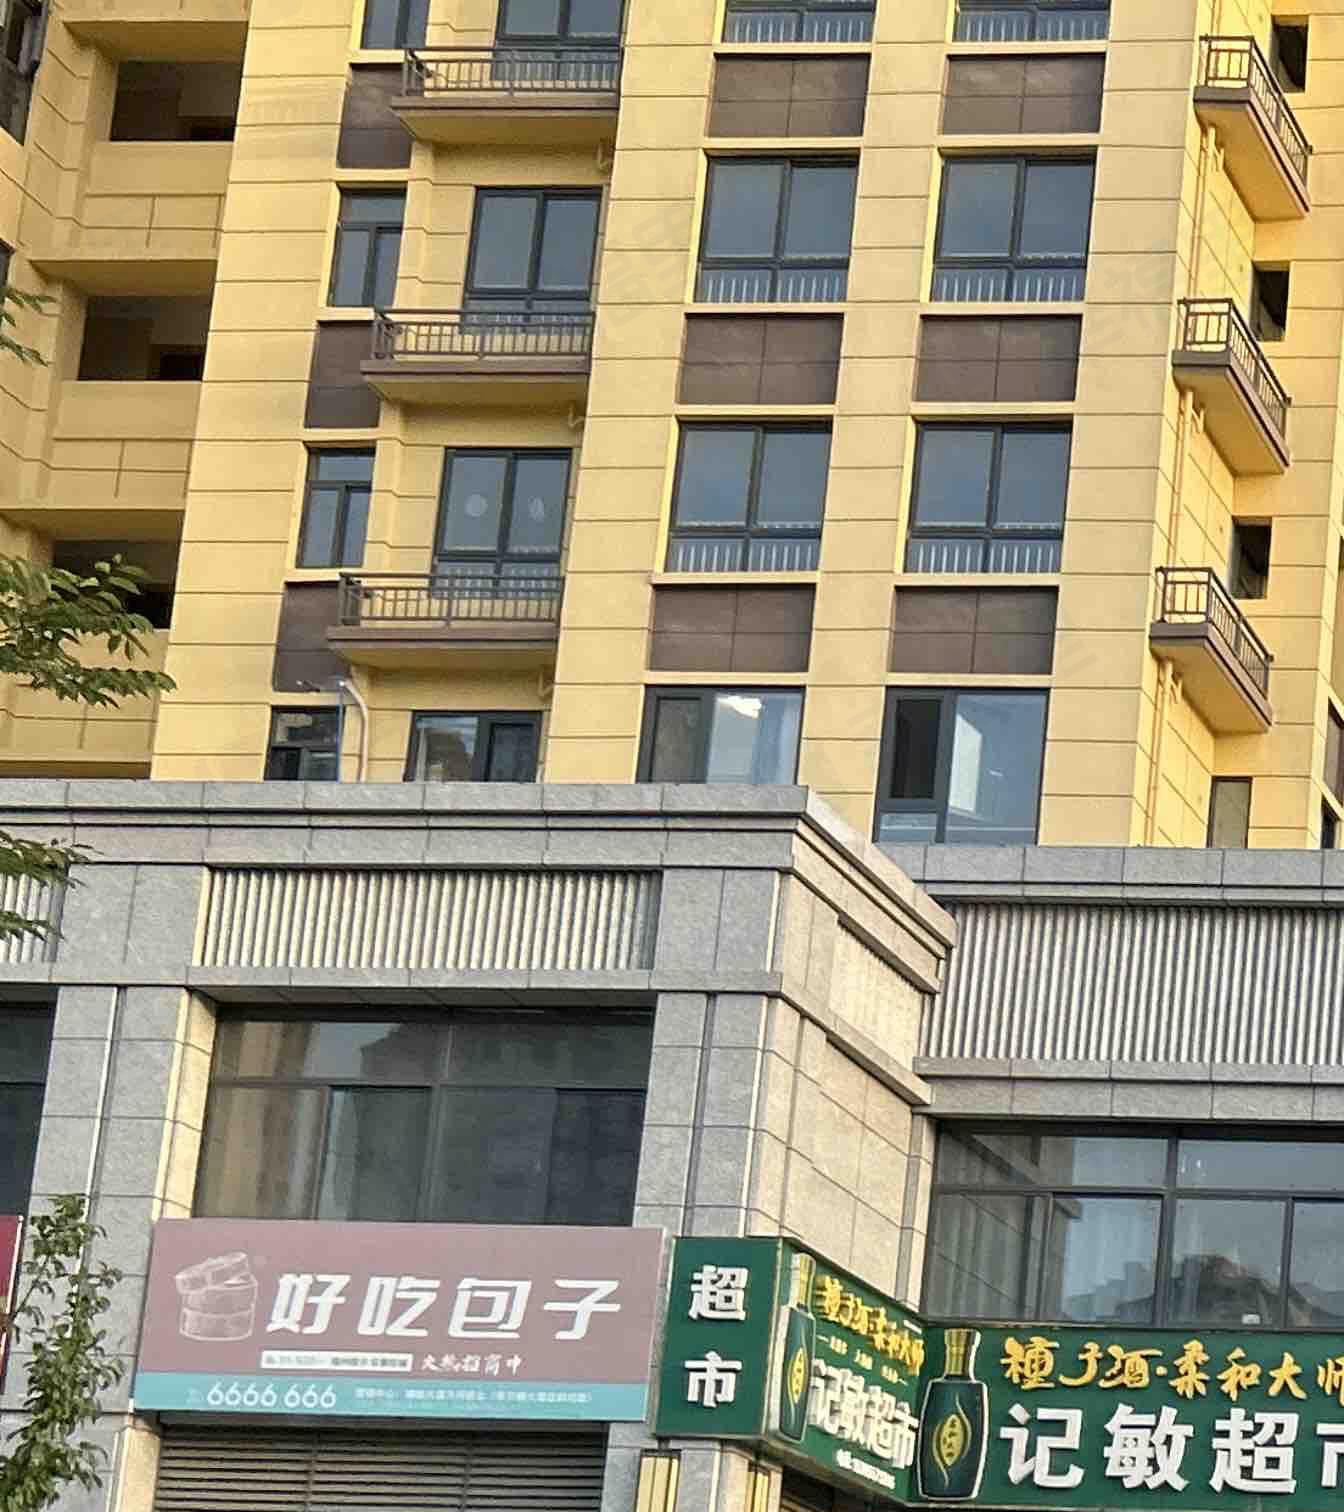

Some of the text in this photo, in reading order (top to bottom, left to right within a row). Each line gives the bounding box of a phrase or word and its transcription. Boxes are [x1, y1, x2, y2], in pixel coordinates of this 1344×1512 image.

[266, 1273, 622, 1340] 好吃包子
[684, 1264, 749, 1408] 超市
[206, 1382, 279, 1408] 6666
[283, 1385, 337, 1409] 666
